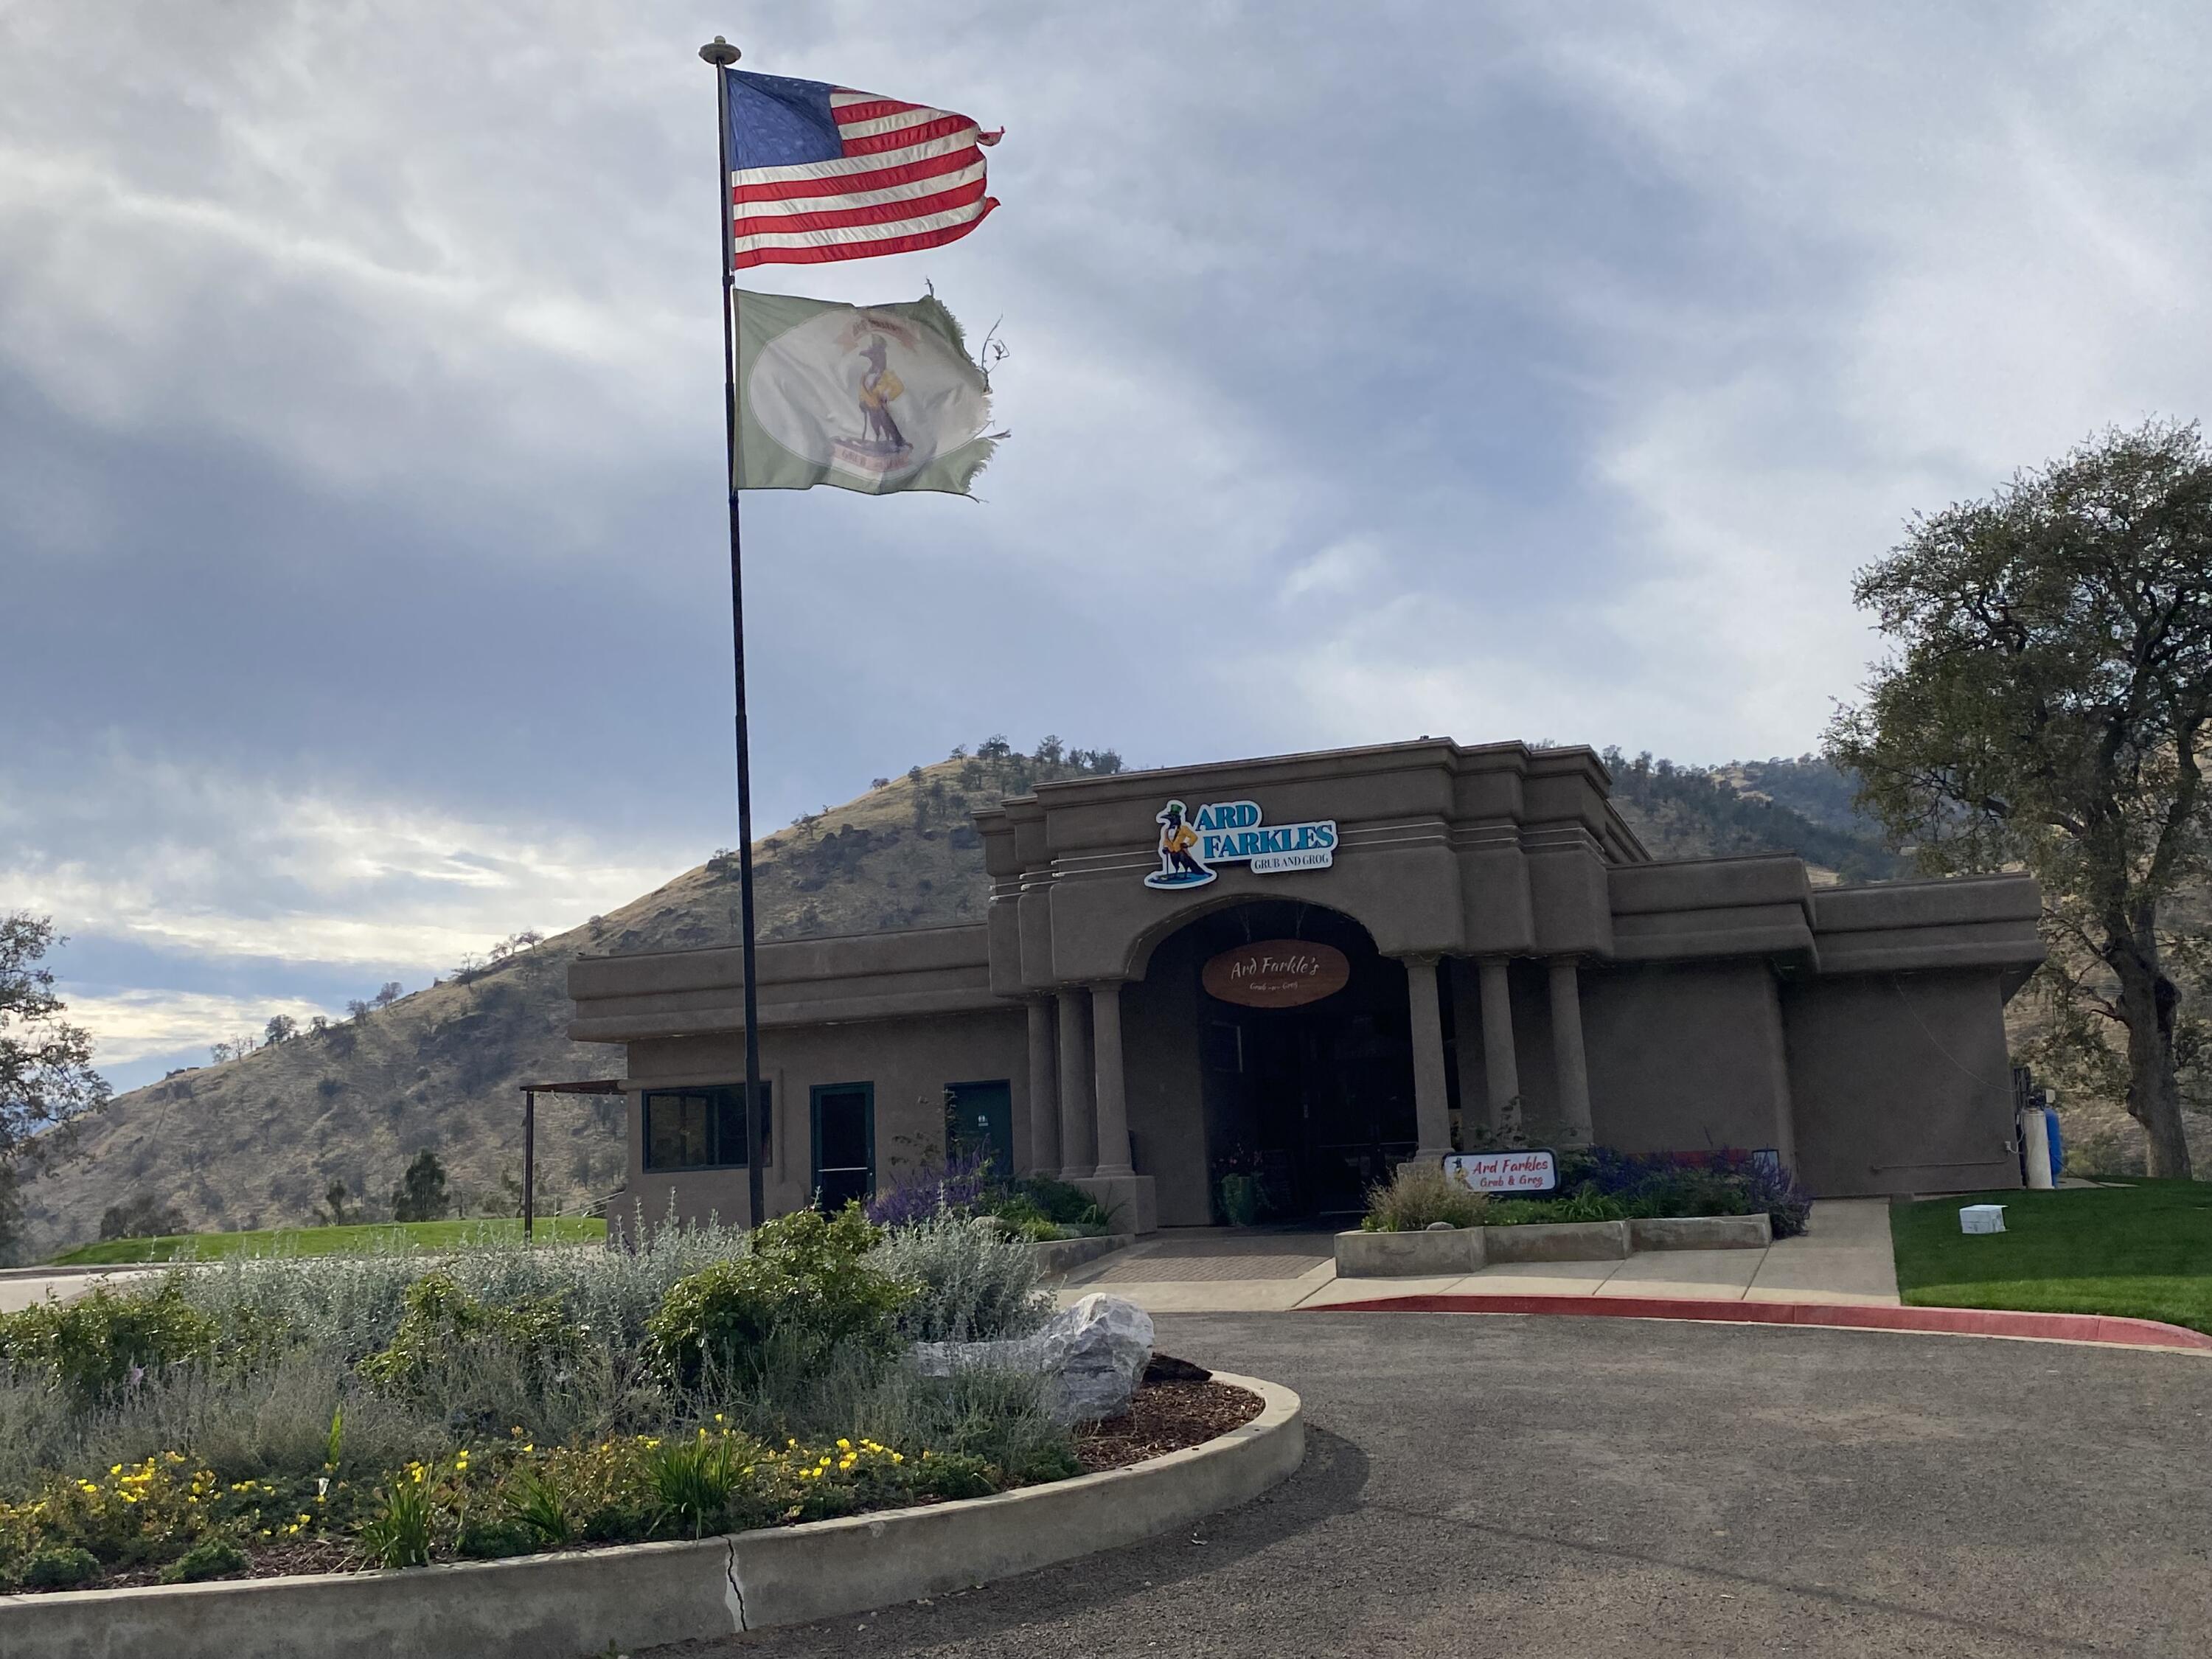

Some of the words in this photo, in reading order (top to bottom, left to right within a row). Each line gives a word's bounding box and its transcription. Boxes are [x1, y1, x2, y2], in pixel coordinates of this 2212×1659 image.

[1195, 805, 1258, 831] ARD
[1203, 825, 1334, 858] FARKLES
[1254, 858, 1280, 870] GRUB
[1281, 856, 1301, 867] AND
[1302, 854, 1329, 866] GROG
[1231, 958, 1257, 980] Ard
[1262, 956, 1320, 975] Farkle's
[1472, 1160, 1498, 1175] Ard
[1503, 1156, 1548, 1173] Farkles
[1481, 1176, 1503, 1187] Grub
[1508, 1175, 1514, 1186] &
